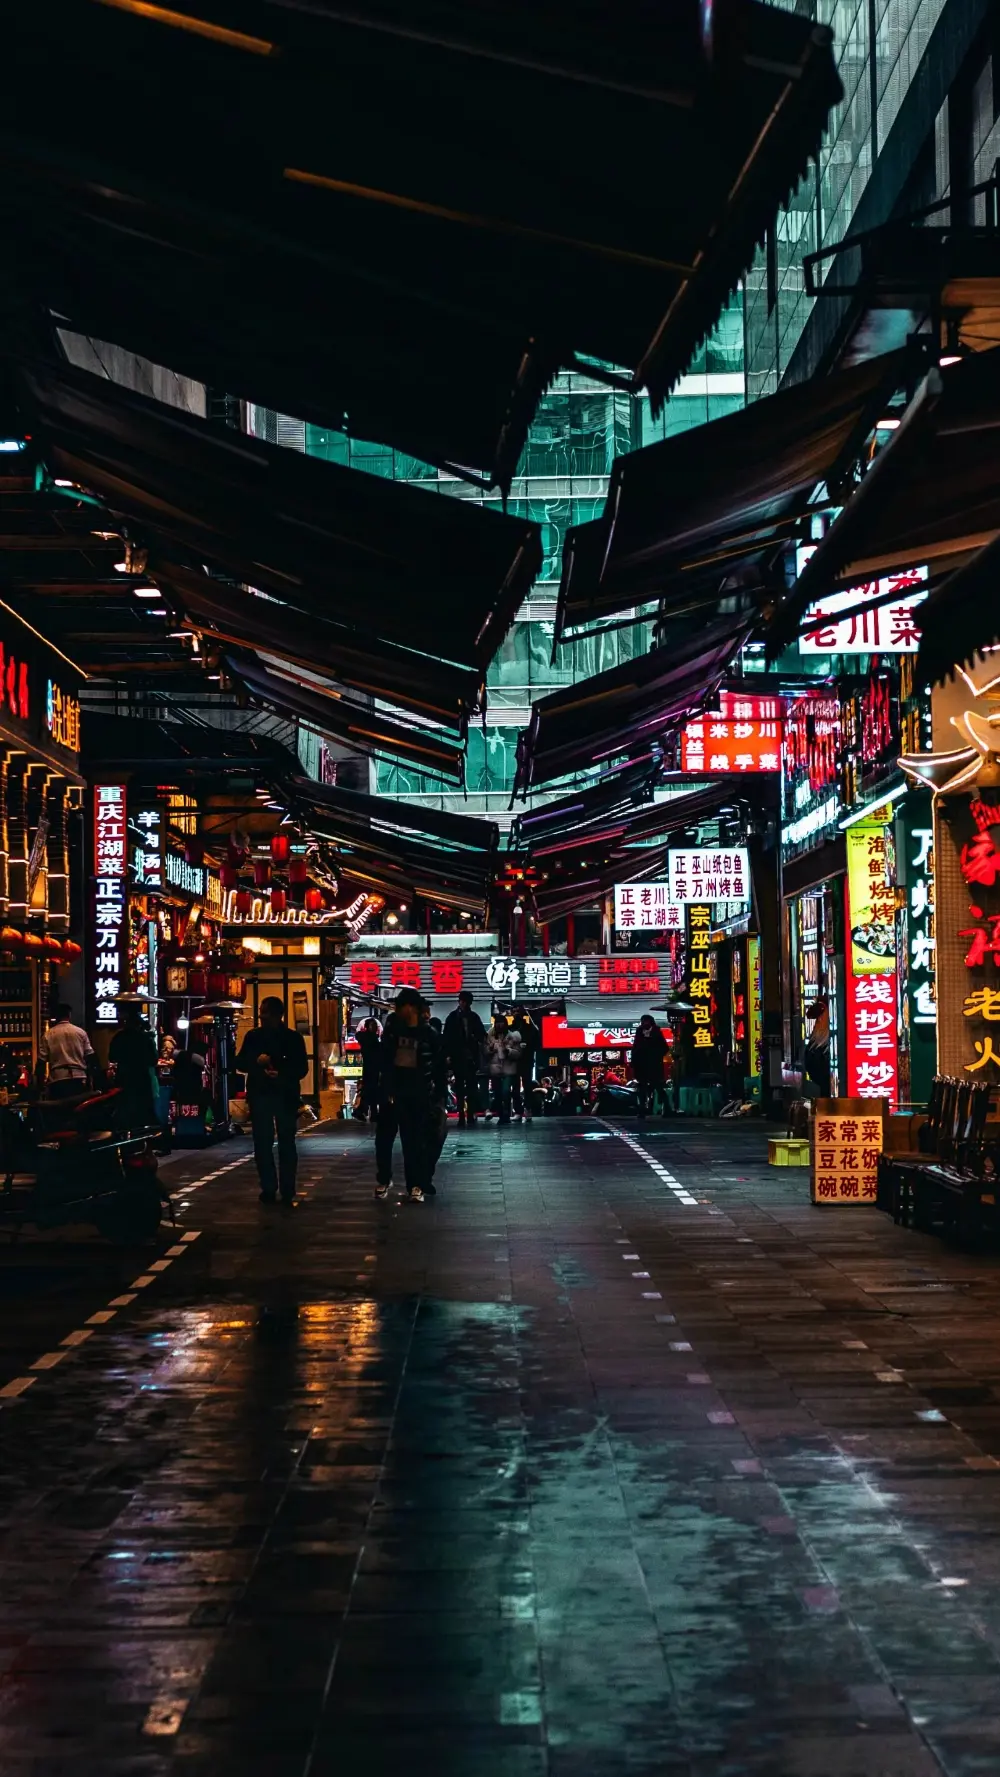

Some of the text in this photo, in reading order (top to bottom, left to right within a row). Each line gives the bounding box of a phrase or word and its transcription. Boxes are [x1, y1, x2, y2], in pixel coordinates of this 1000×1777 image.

[758, 722, 778, 770] 川菜
[96, 786, 124, 875] 重庆江湖菜
[692, 854, 743, 875] 巫山纸包鱼
[675, 855, 687, 900] 正宗
[692, 876, 745, 899] 万州烤鱼
[640, 887, 675, 906] 老川
[640, 907, 680, 927] 江湖菜
[95, 878, 123, 1023] 正宗万州烤鱼
[350, 960, 464, 993] 串串香
[689, 905, 715, 1048] 宗巫山纸包鱼
[818, 1119, 881, 1143] 家常菜
[818, 1148, 879, 1170] 豆花饭
[818, 1175, 878, 1198] 碗碗菜
